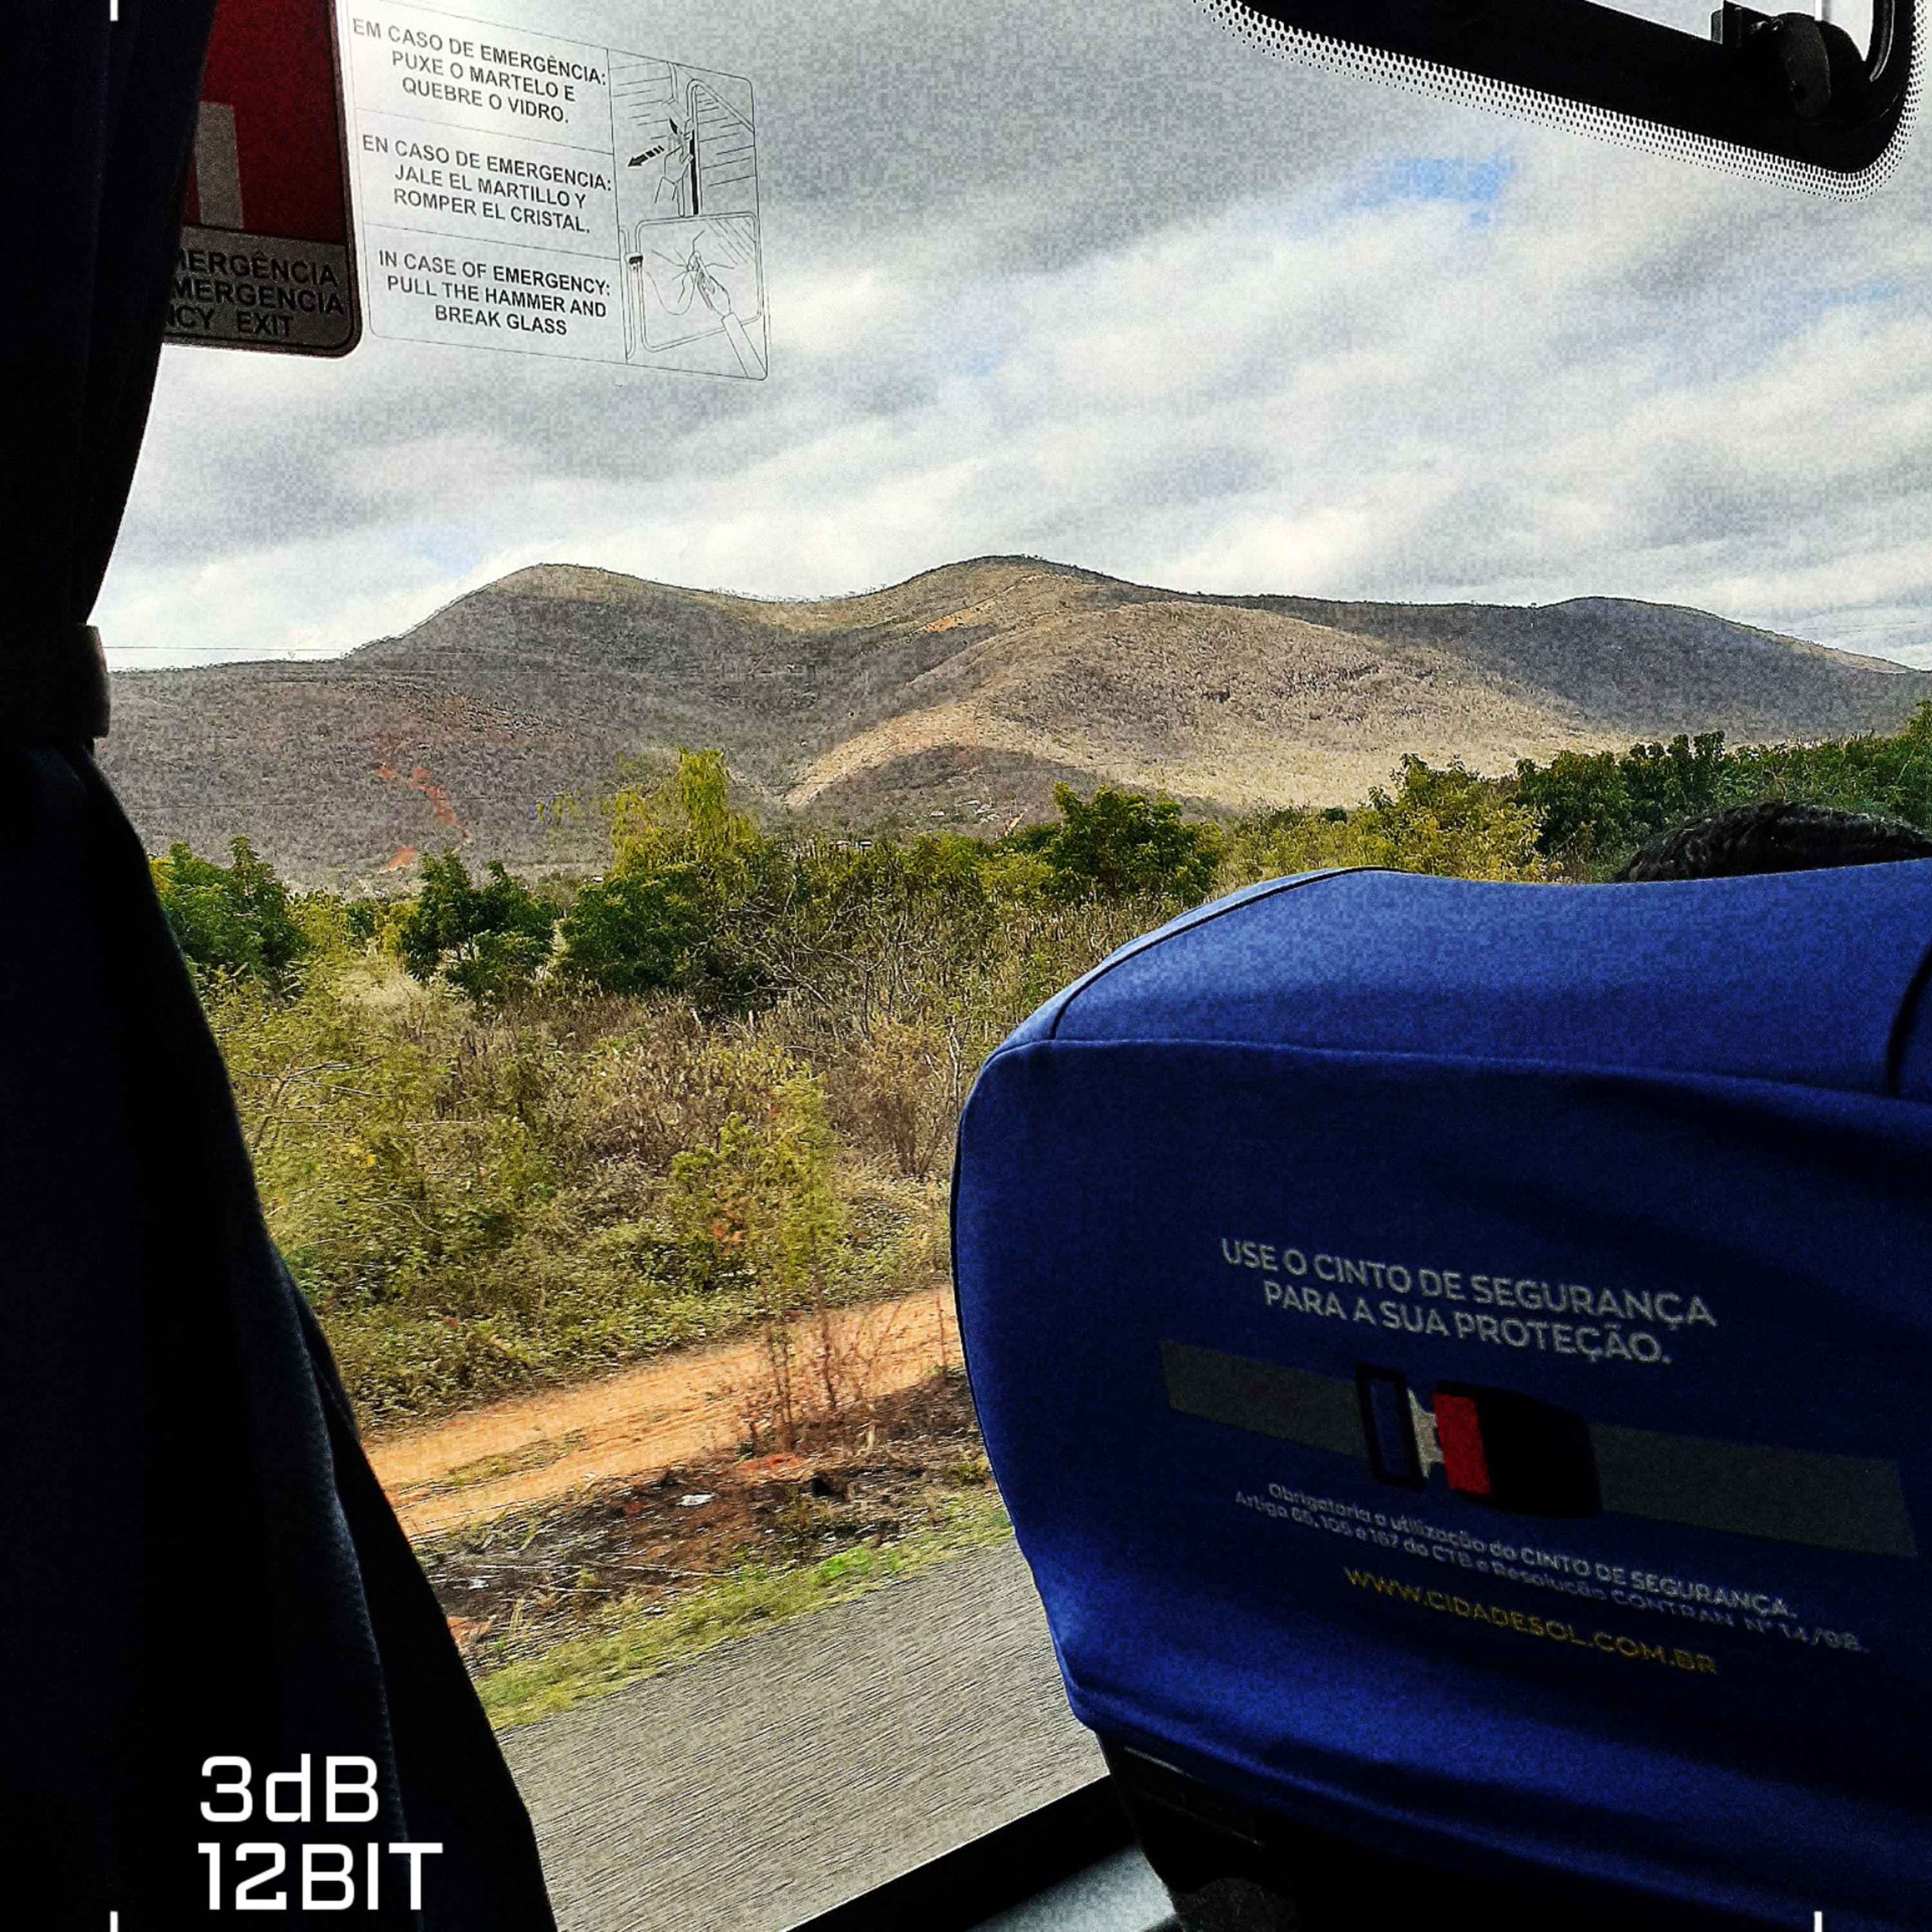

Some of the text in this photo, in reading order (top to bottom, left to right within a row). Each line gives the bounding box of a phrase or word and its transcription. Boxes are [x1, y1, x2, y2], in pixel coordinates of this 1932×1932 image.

[353, 18, 606, 86] EM CASO DE EMERGÊNCIA:
[392, 50, 576, 102] PUXE O MARTELO E
[402, 77, 569, 123] QUEBRE O VIDRO.
[363, 134, 612, 191] EN CASO DE EMERGENCIA:
[395, 165, 586, 209] JALE EL MARTILLO Y
[393, 188, 591, 234] ROMPER EL CRISTAL.
[379, 249, 611, 296] IN CASE OF EMERGENCY:
[387, 275, 606, 318] PULL THE HAMMER AND
[237, 310, 294, 337] EXIT
[435, 305, 567, 336] BREAK GLASS
[1221, 1238, 1719, 1331] USE O CINTO DE SEGURANÇA
[1264, 1278, 1672, 1365] PARA A SUA PROTEÇÃO.
[1235, 1490, 1289, 1518] Artigo
[1610, 1589, 1736, 1627] CONTRAN
[1520, 1547, 1591, 1577] CINTO
[1595, 1562, 1627, 1587] DE
[1629, 1569, 1797, 1620] SEGURANÇA.
[1343, 1566, 1718, 1674] WWW.CIDADESOL.COM.BR
